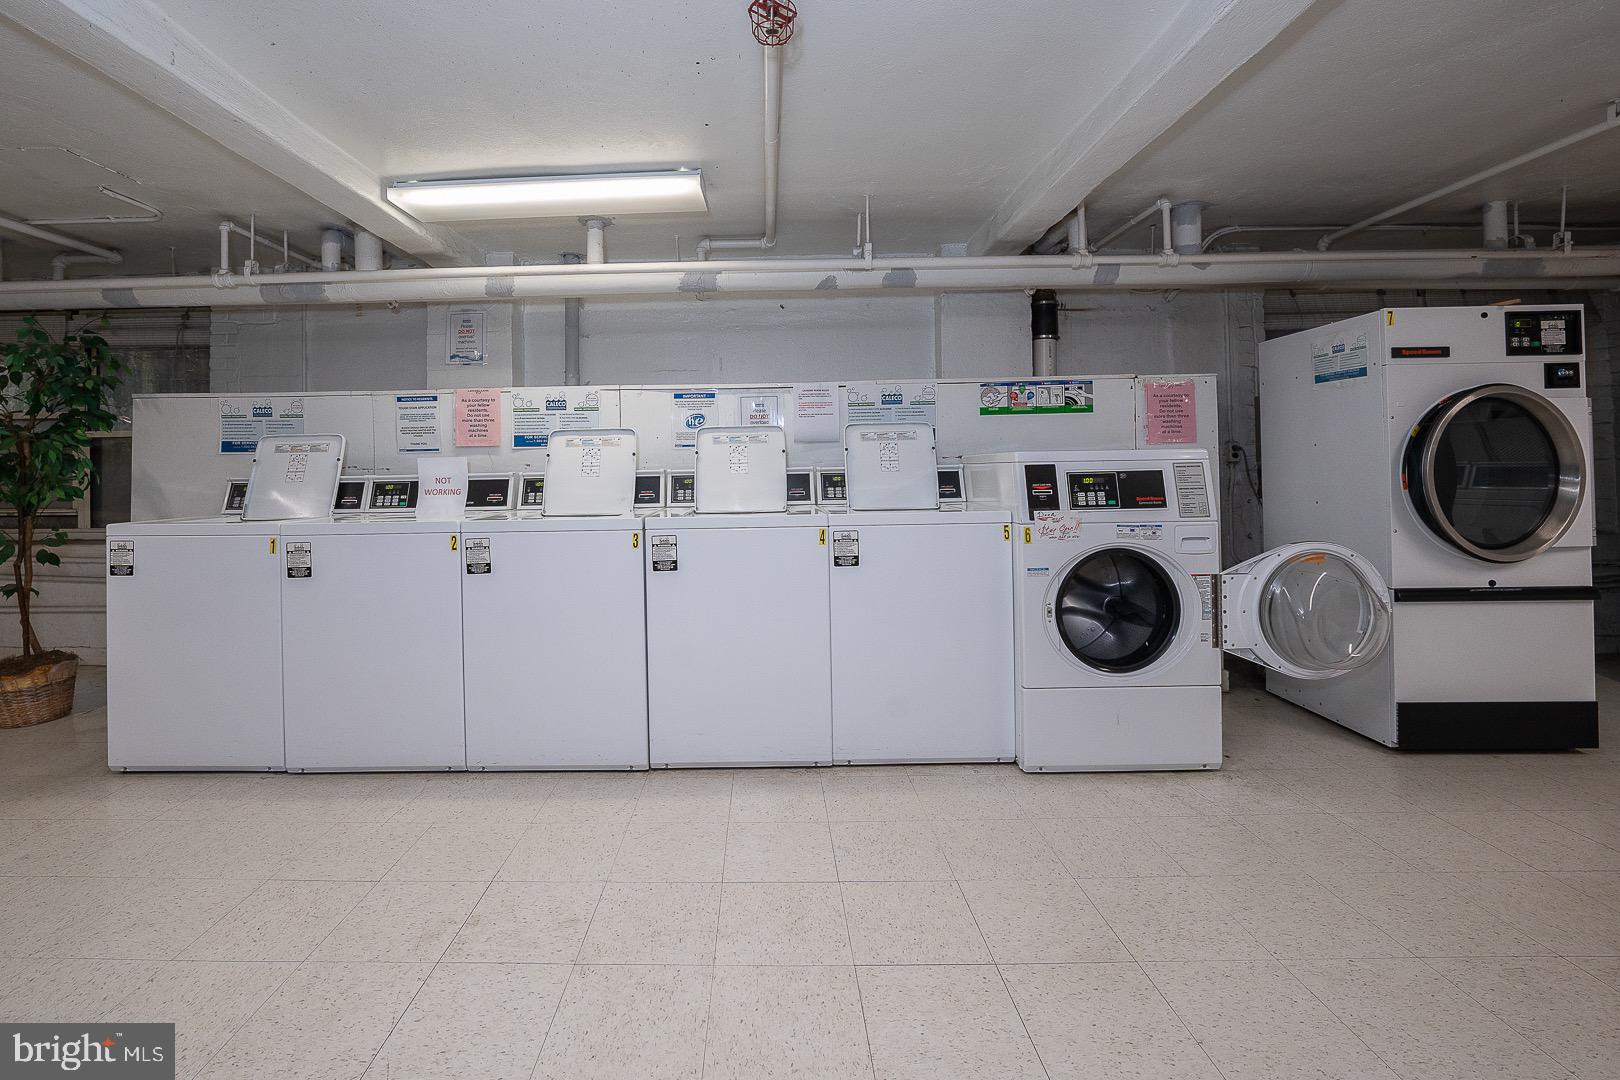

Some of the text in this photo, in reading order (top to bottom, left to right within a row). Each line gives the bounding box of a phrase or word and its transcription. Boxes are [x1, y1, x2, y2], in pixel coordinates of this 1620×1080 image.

[820, 530, 825, 544] 4
[1004, 525, 1010, 540] 5
[1025, 528, 1031, 543] 6
[451, 536, 457, 550] 2
[632, 534, 639, 548] 3
